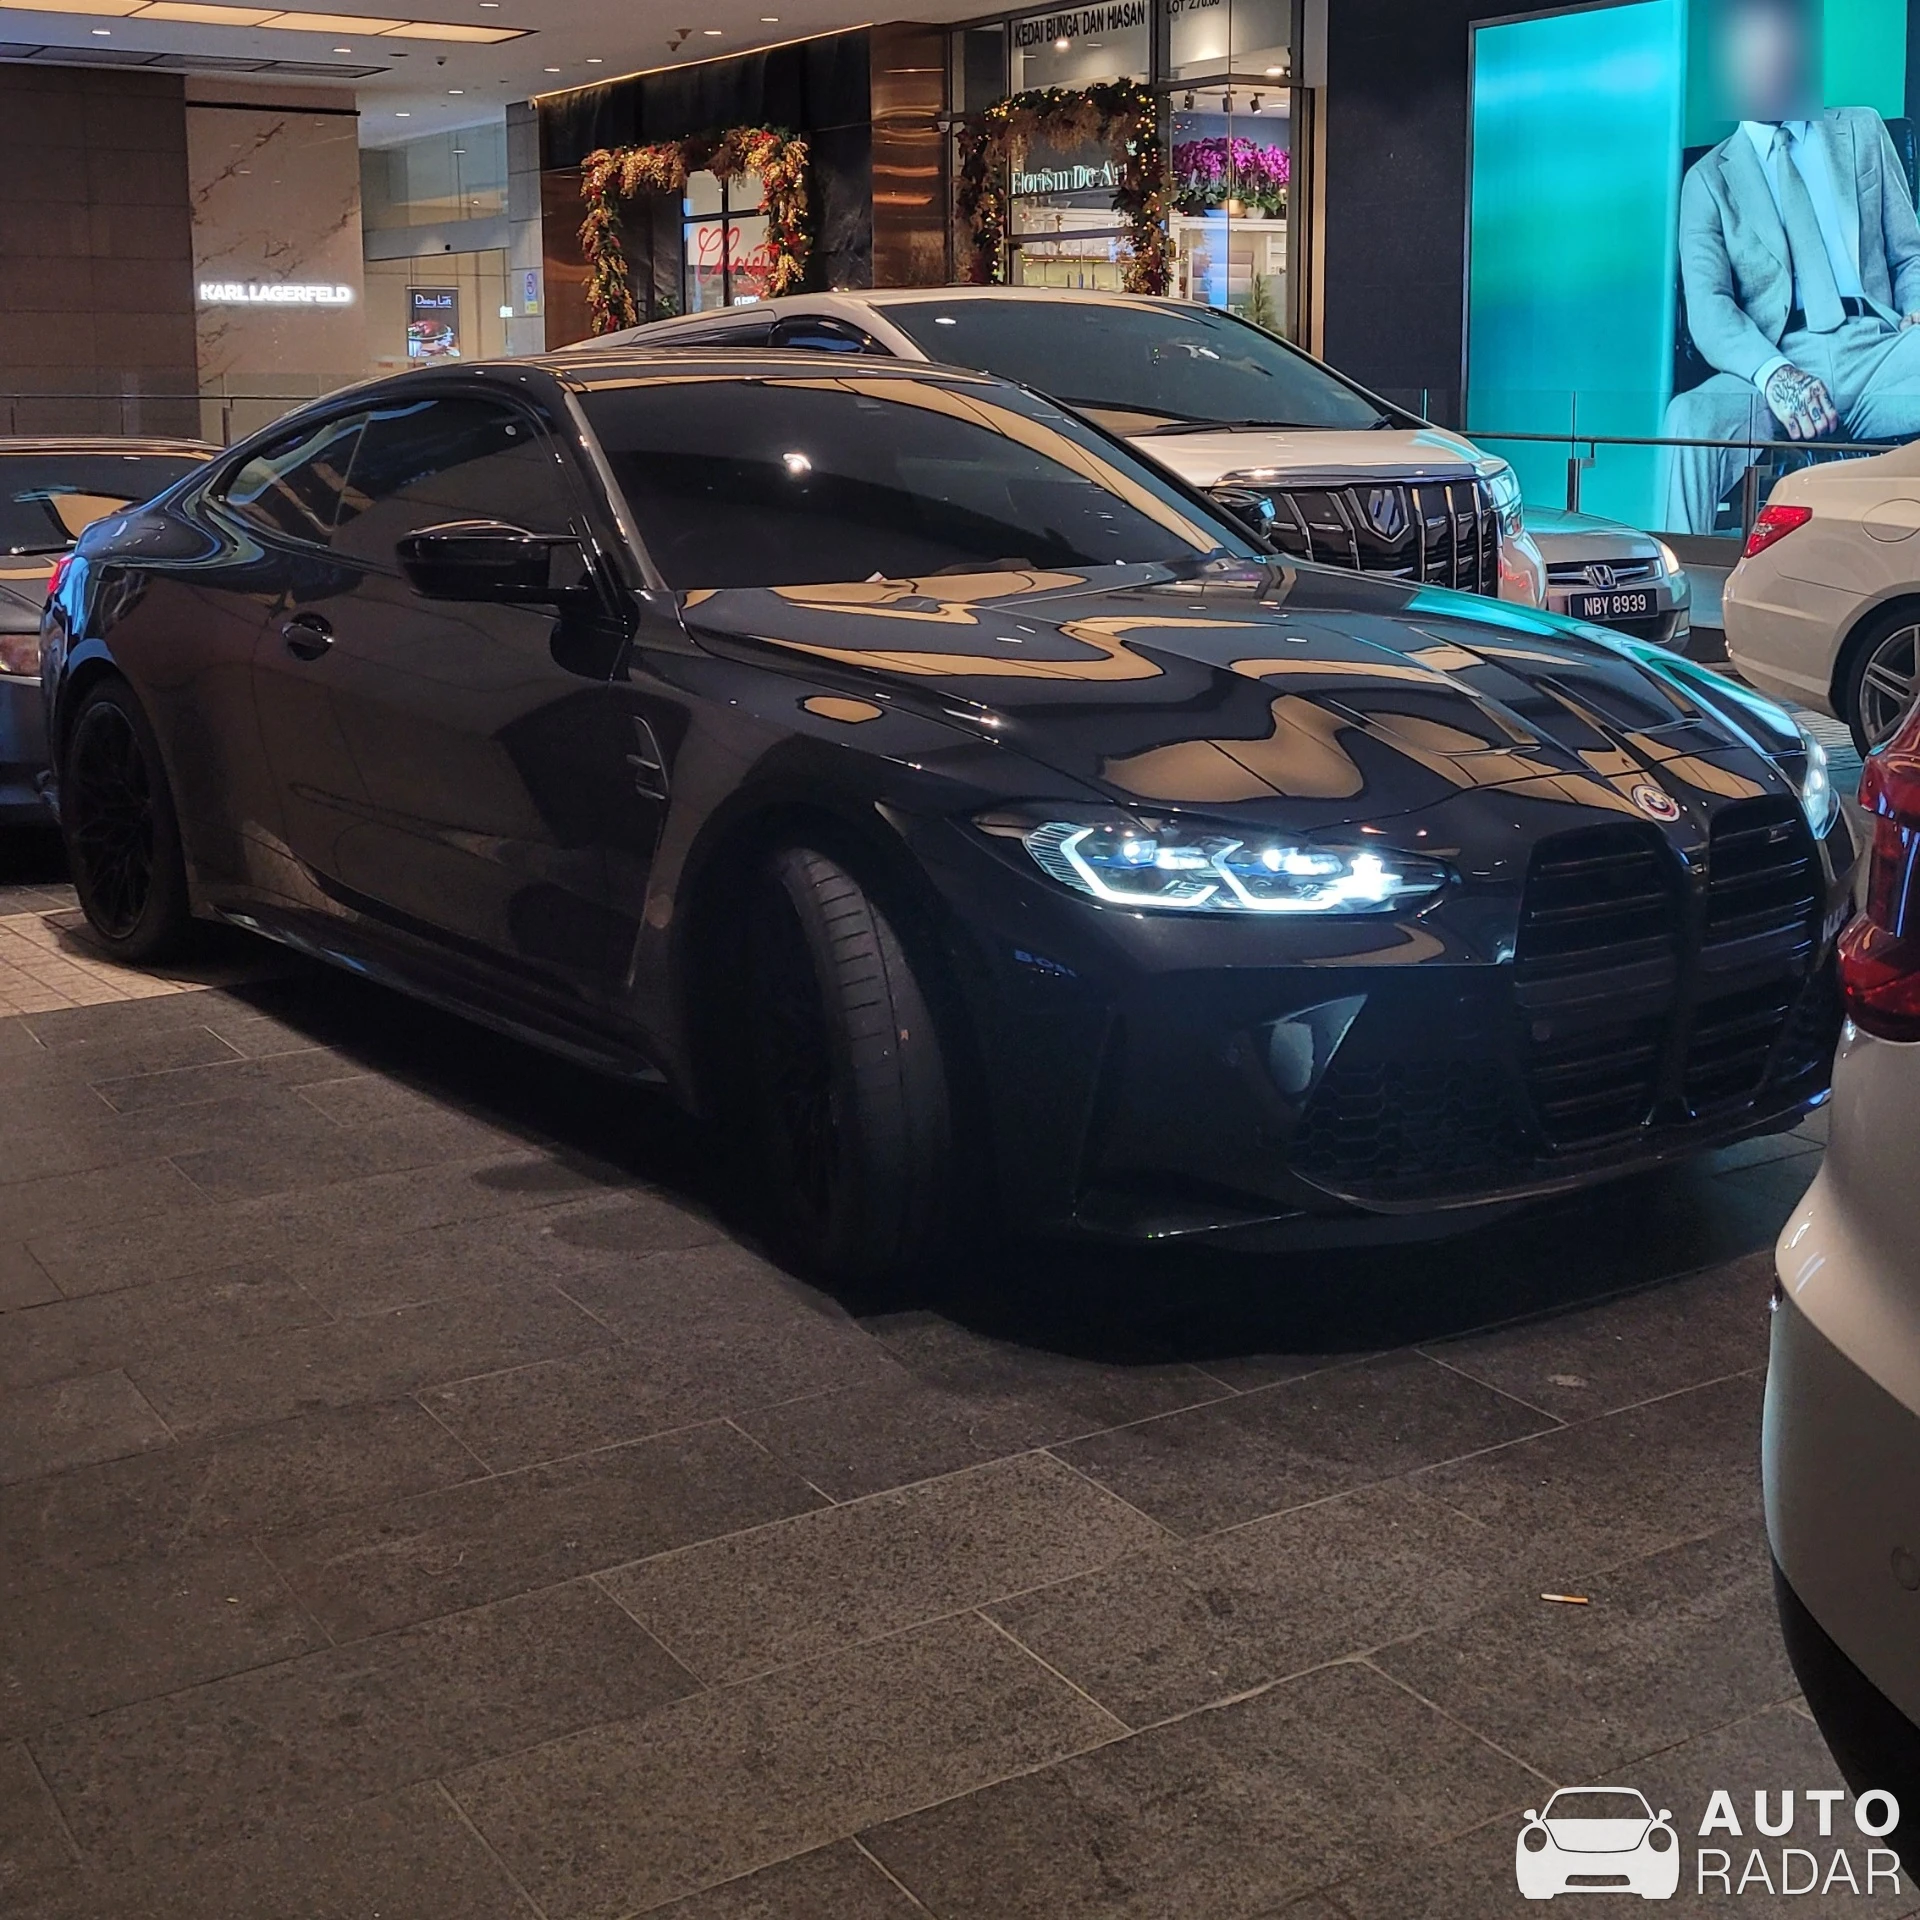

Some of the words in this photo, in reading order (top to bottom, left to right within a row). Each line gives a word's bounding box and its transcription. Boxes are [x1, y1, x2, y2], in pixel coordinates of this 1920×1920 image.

[1166, 0, 1184, 14] LOT
[1015, 20, 1044, 48] KEDAI
[1046, 13, 1079, 41] BUNGA
[1083, 9, 1104, 35] DAN
[1073, 164, 1099, 188] De
[200, 284, 249, 301] KARL
[249, 284, 351, 302] LAGERFELD
[1584, 597, 1609, 616] NBY
[1612, 594, 1647, 614] 8939
